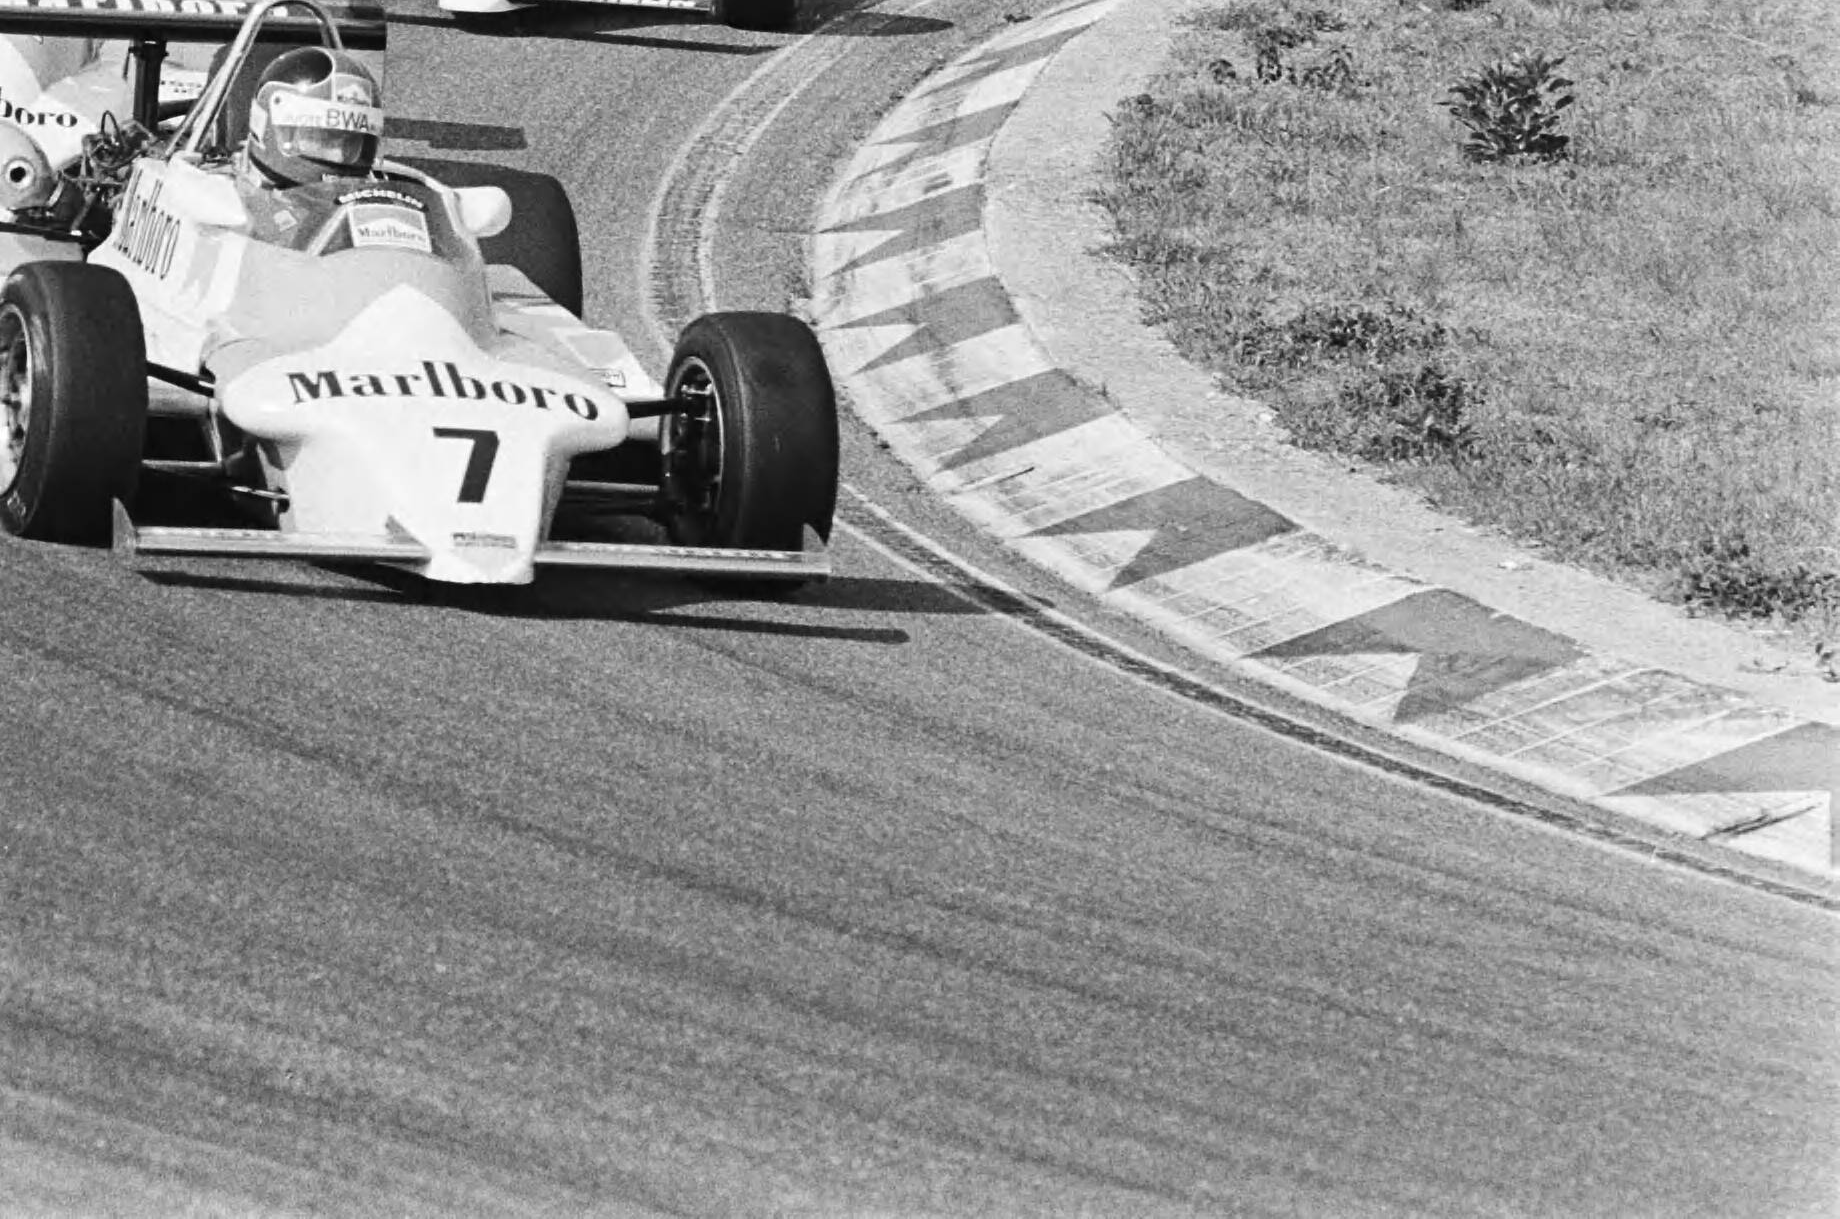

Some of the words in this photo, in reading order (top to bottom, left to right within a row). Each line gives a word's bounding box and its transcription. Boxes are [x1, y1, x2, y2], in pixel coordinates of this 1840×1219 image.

[338, 188, 424, 209] MICHELIN
[286, 359, 599, 421] Marlboro
[432, 427, 500, 504] 7
